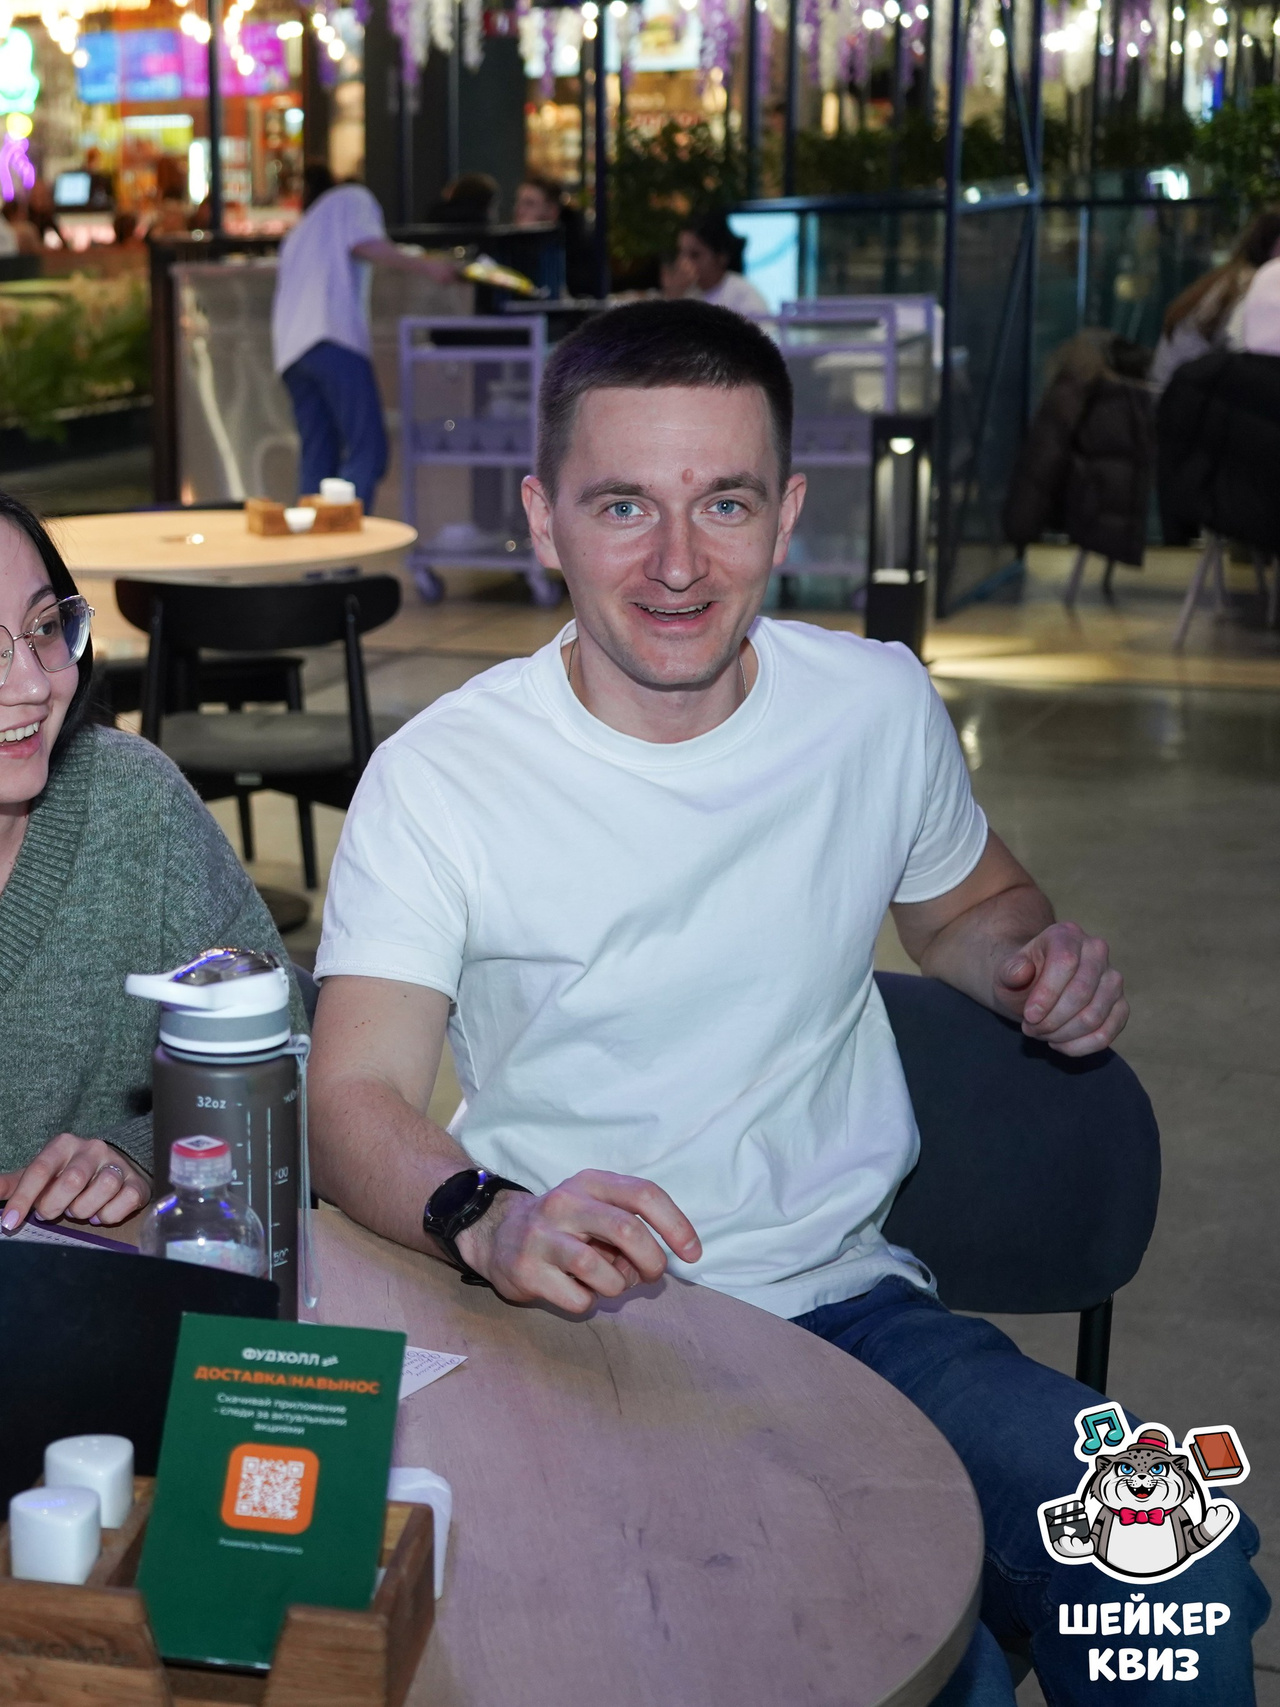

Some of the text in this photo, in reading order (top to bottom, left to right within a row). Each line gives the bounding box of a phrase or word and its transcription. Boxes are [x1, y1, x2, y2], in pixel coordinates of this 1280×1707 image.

[196, 1095, 227, 1110] 32oz
[241, 1347, 321, 1367] ФУДХОЛЛ
[216, 1392, 348, 1415] Скачивай приложение
[220, 1406, 255, 1419] следи
[271, 1411, 348, 1427] актуальными
[252, 1422, 305, 1436] акциями
